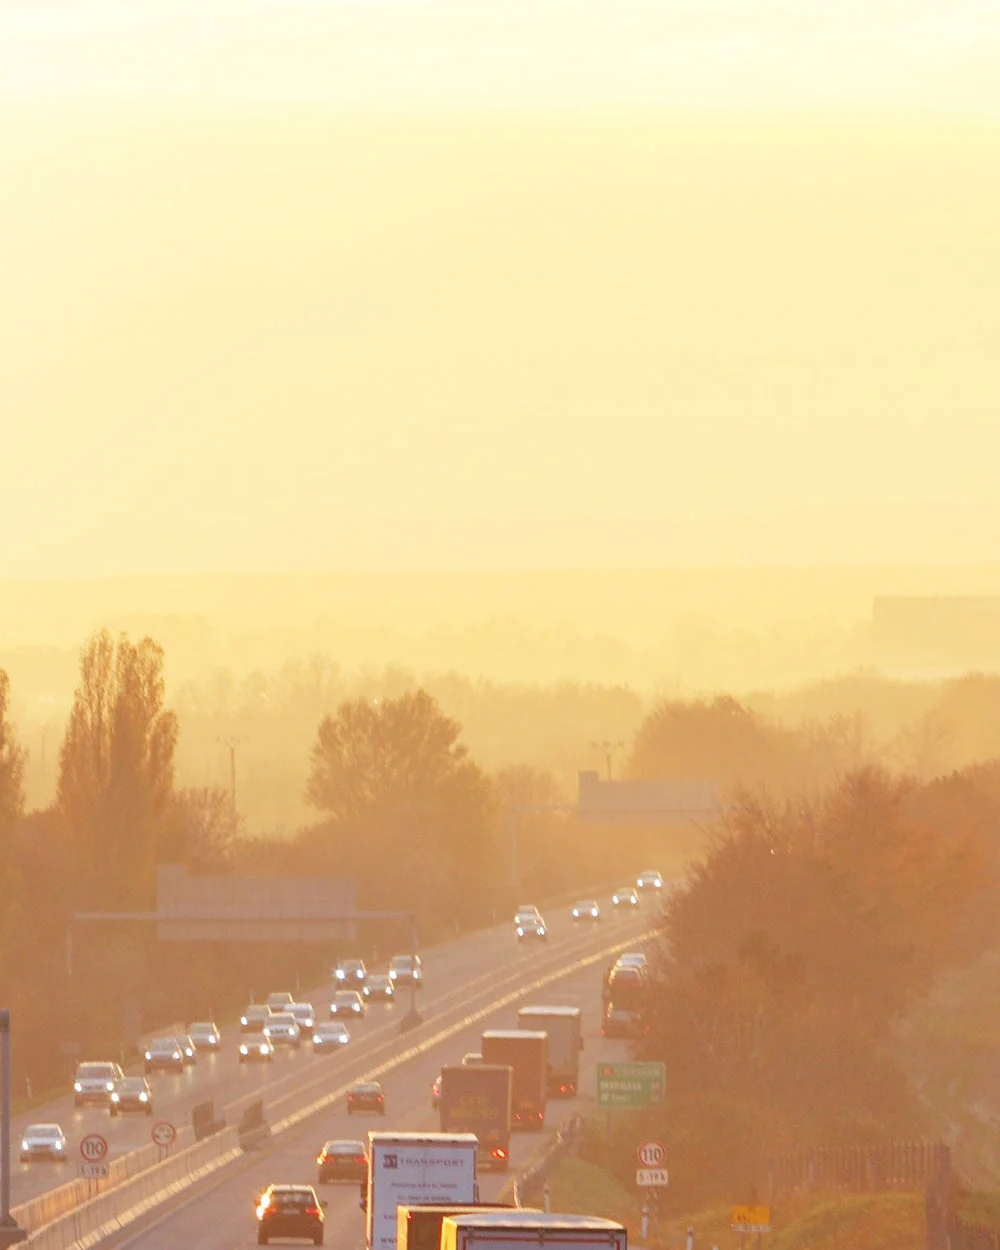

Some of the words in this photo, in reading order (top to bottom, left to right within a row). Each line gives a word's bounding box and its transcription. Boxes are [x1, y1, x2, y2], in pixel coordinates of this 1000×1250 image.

[85, 1141, 104, 1156] 110
[643, 1148, 662, 1162] 110
[399, 1157, 465, 1168] TRANSPORT
